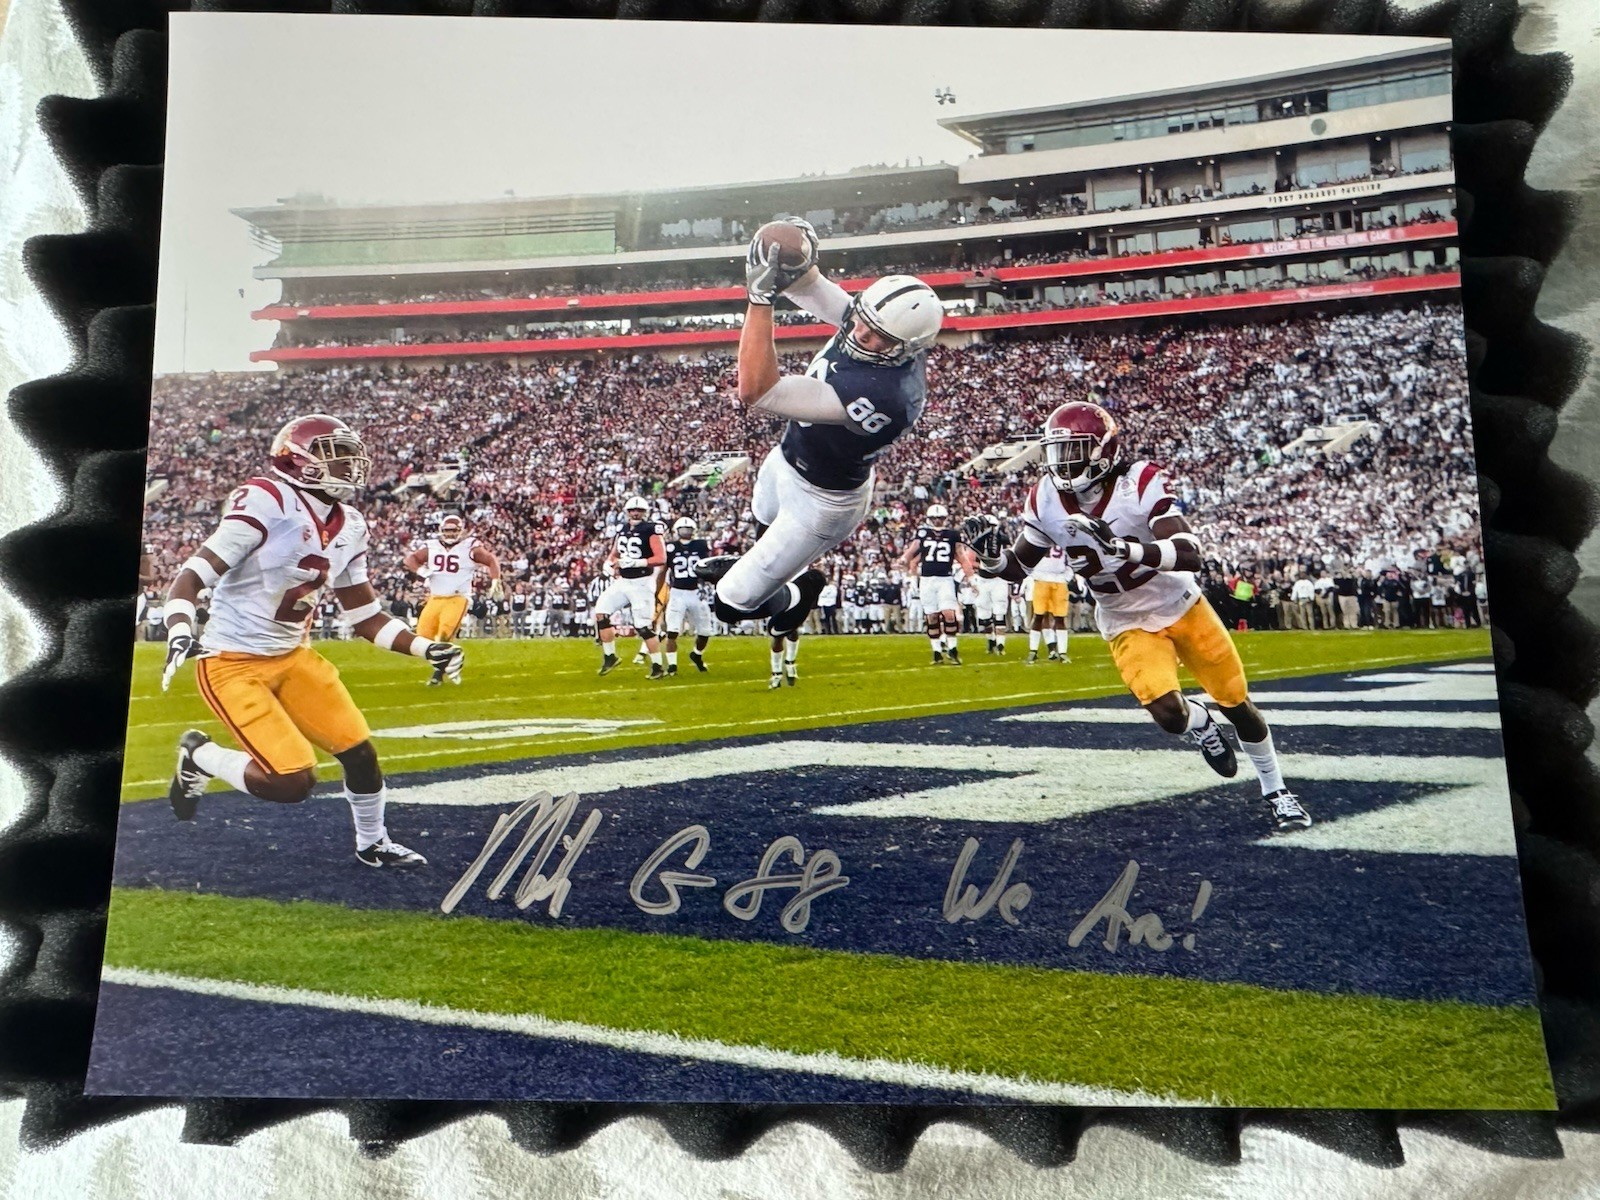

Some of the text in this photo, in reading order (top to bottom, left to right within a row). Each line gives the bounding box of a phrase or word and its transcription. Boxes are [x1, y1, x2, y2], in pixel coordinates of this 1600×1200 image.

[231, 487, 249, 511] 2
[617, 535, 642, 559] 66
[923, 540, 951, 562] 72
[433, 554, 460, 573] 96
[274, 553, 331, 623] 2
[943, 836, 1033, 925] We
